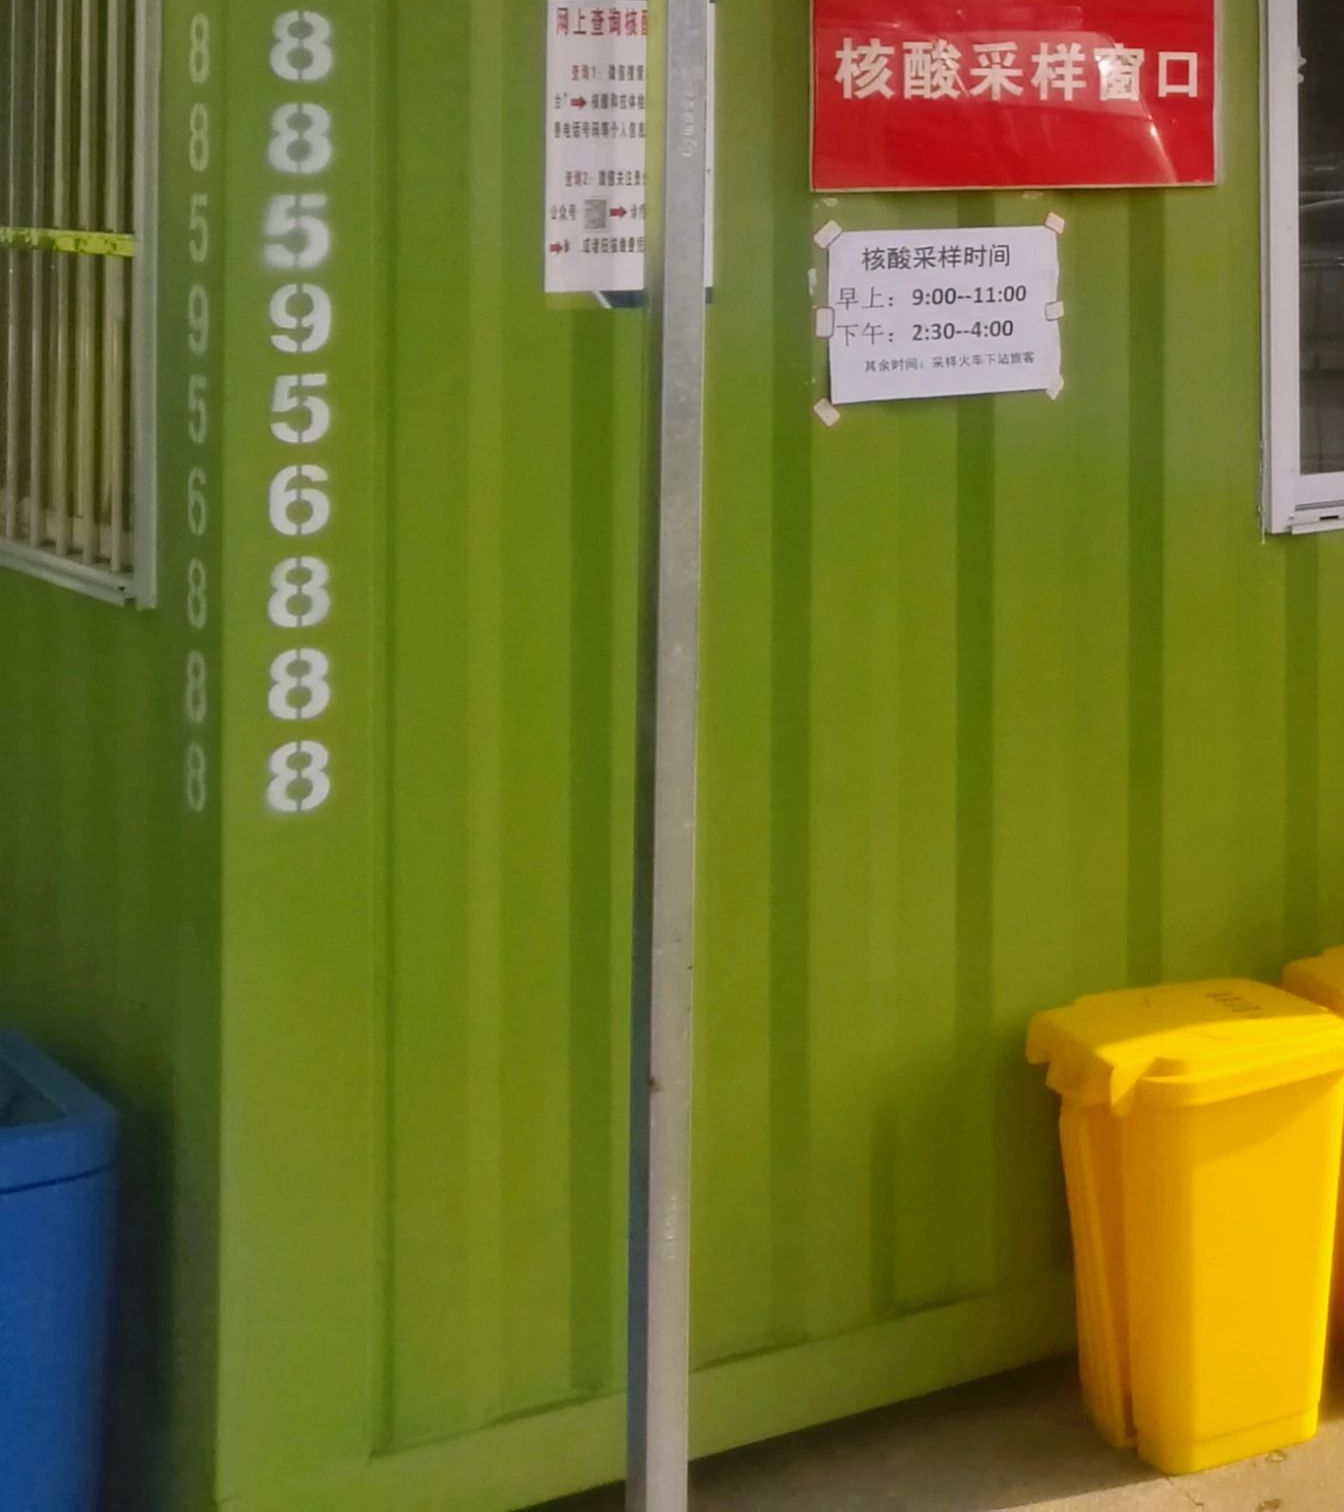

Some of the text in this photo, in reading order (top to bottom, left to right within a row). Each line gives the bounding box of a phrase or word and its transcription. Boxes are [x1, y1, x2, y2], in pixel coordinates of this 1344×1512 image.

[834, 37, 1199, 102] 核酸采样窗口
[861, 244, 1011, 271] 核酸采样时间
